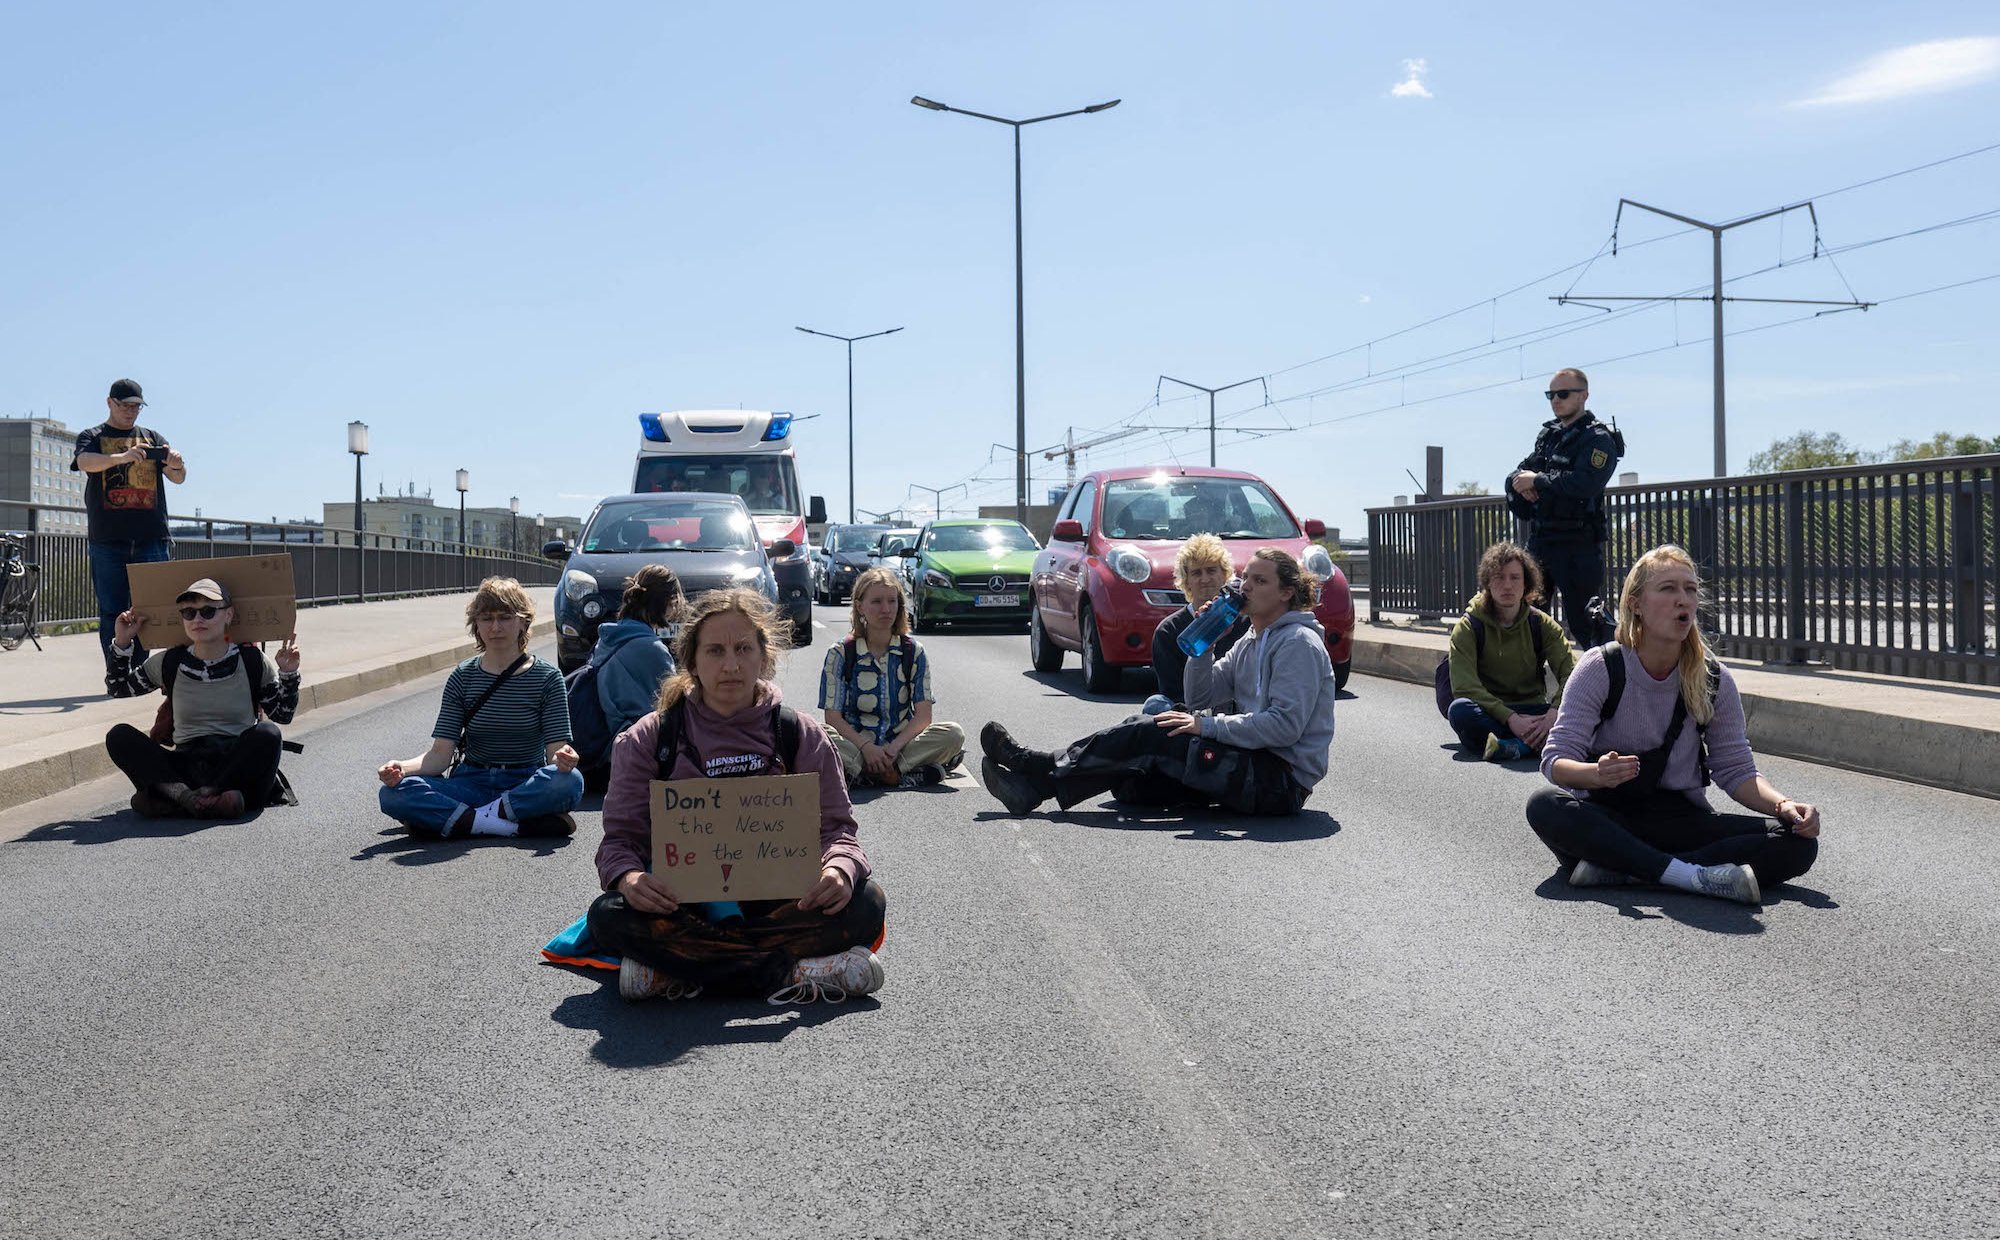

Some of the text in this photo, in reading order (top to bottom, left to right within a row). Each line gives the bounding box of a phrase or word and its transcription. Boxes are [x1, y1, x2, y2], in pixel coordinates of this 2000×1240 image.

[706, 759, 765, 777] GEGEN ÖL
[665, 787, 793, 811] Don't watch
[679, 815, 785, 834] the News
[665, 841, 808, 867] Be the News
[720, 863, 733, 893] !
